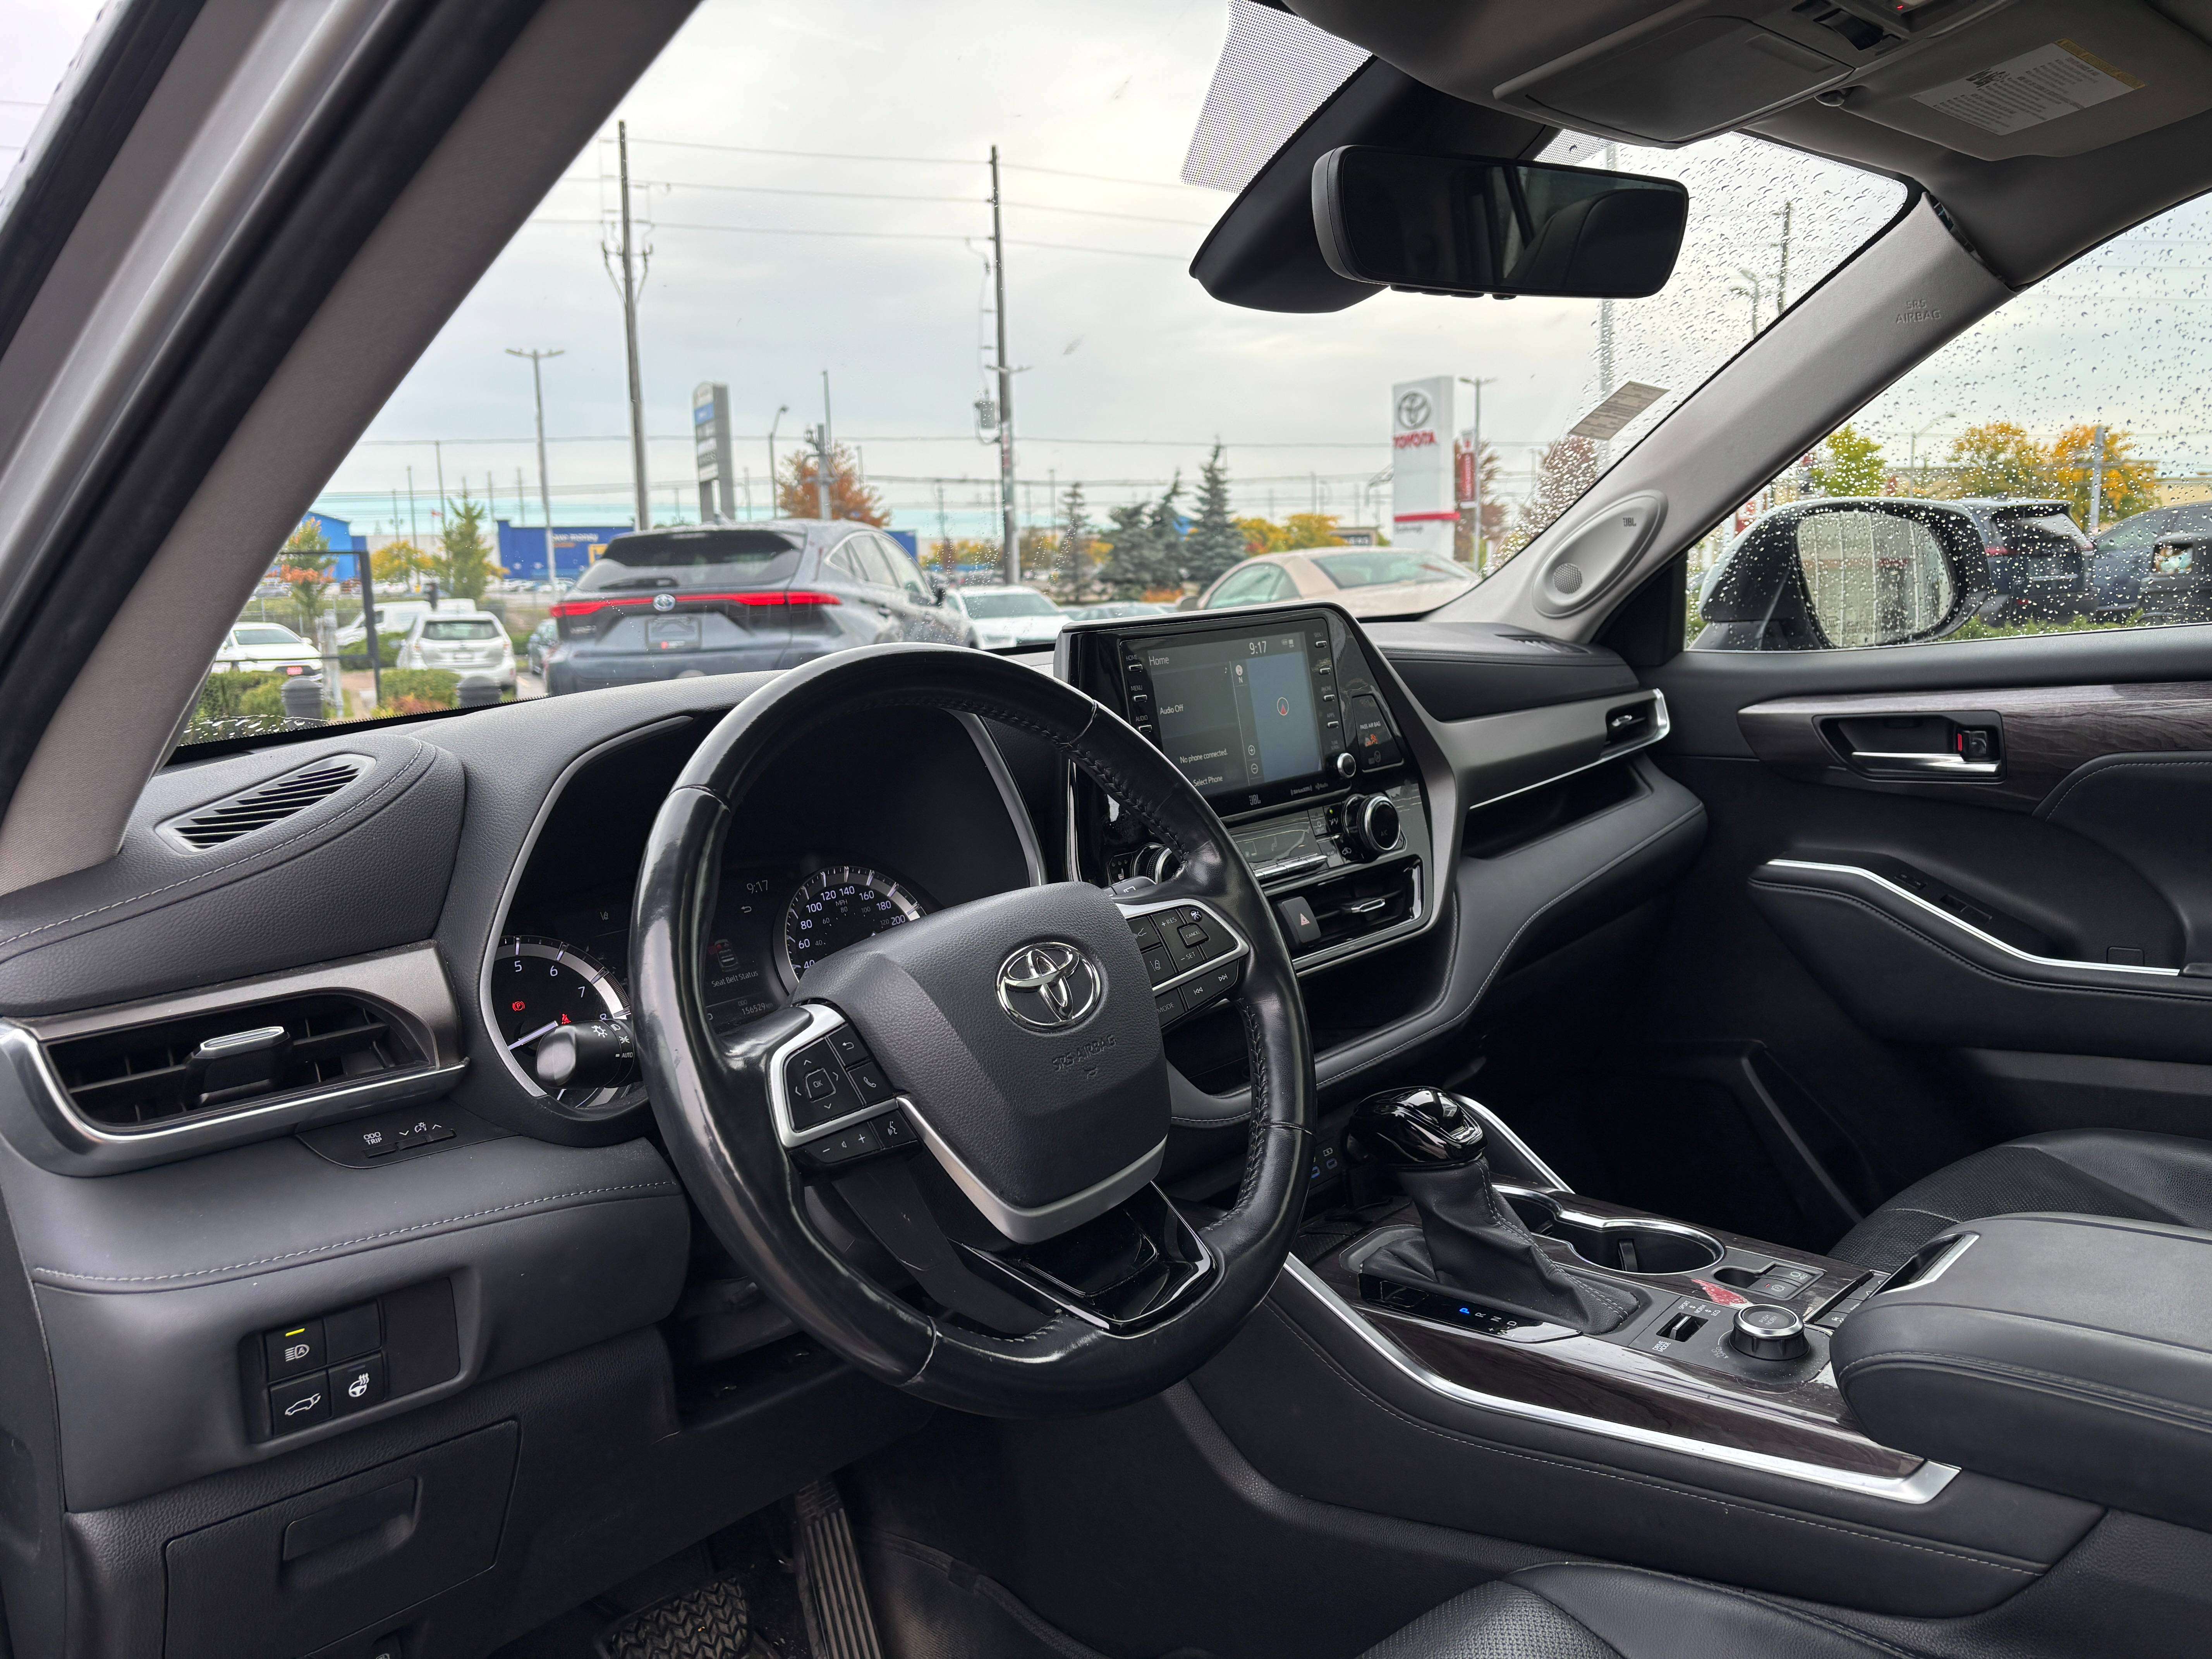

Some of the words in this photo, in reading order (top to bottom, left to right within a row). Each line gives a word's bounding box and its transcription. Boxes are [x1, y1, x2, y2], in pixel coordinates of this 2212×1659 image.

[1896, 309, 1941, 324] AIRBAG
[1393, 431, 1437, 449] TOYOTA
[1623, 517, 1637, 527] JBL
[1249, 641, 1267, 655] 9:17
[1149, 656, 1170, 666] Home
[1160, 705, 1175, 715] Audio
[1175, 704, 1184, 713] Off
[1188, 754, 1203, 764] phone
[1203, 748, 1228, 760] connected.
[1193, 777, 1208, 787] Select
[1208, 775, 1223, 785] Phone
[1249, 793, 1261, 806] JBL
[747, 880, 768, 894] 9:17
[839, 886, 855, 896] 140
[820, 890, 836, 901] 120
[859, 890, 874, 901] 160
[806, 902, 822, 913] 100
[835, 899, 848, 907] MPH
[876, 900, 891, 911] 180
[800, 919, 812, 930] 80
[891, 914, 906, 926] 200
[1166, 917, 1177, 925] RES
[1186, 930, 1200, 938] CANCEL
[799, 938, 811, 949] 60
[1186, 951, 1195, 960] SET
[514, 960, 522, 972] 5
[804, 959, 815, 969] 40
[550, 965, 558, 977] 6
[711, 979, 726, 988] Seat
[726, 975, 738, 984] Belt
[738, 970, 759, 981] Status
[578, 986, 586, 998] 7
[742, 1002, 766, 1015] 156529
[1157, 1002, 1174, 1014] MODE
[1051, 1052, 1075, 1072] SRS
[1076, 1034, 1116, 1063] AIRBAG
[813, 1080, 823, 1088] OK
[363, 1132, 381, 1140] ODO
[366, 1137, 383, 1145] TRIP
[1652, 1340, 1667, 1351] DRIVE
[1657, 1341, 1671, 1353] MODE
